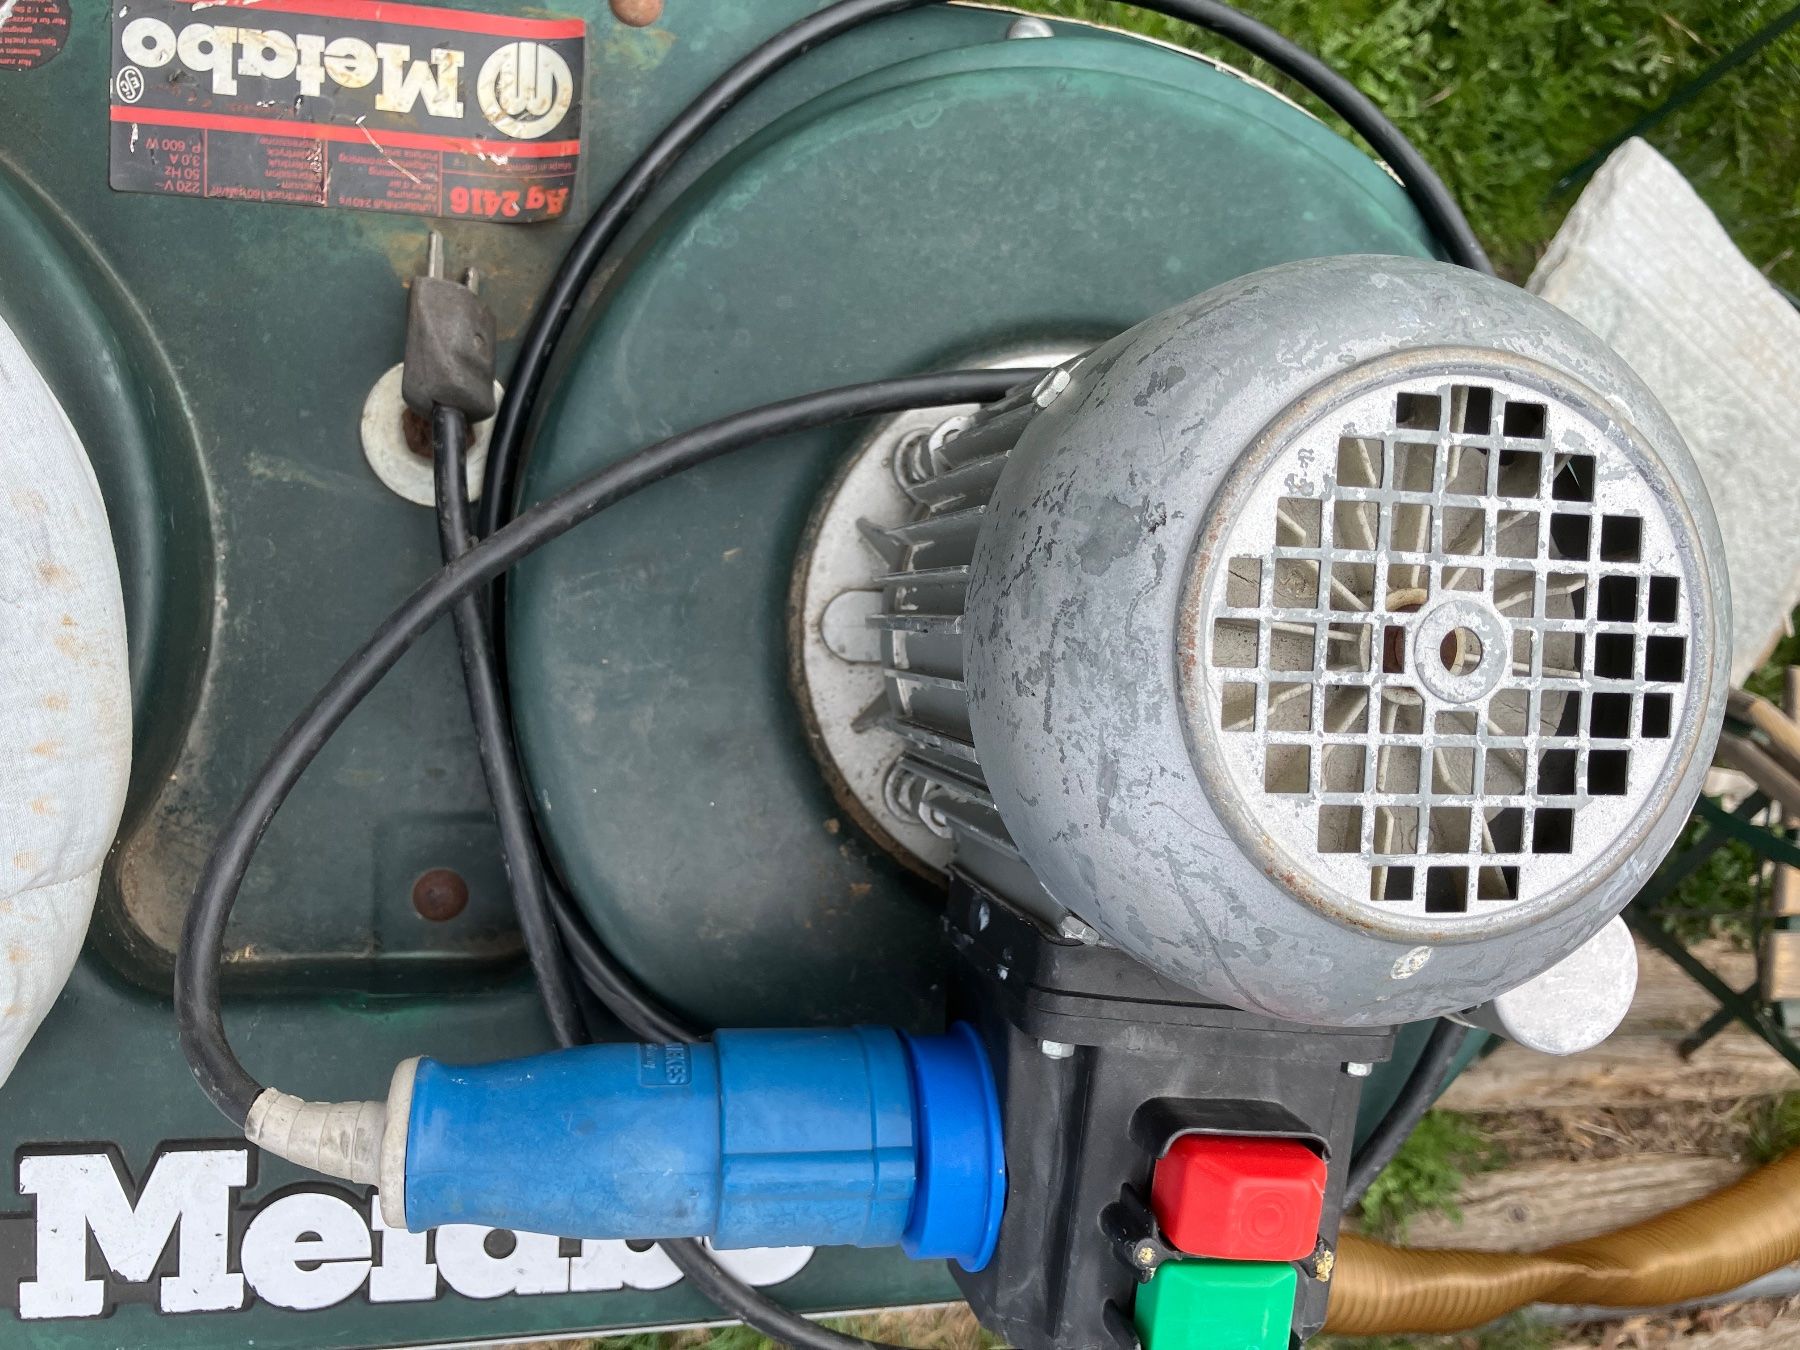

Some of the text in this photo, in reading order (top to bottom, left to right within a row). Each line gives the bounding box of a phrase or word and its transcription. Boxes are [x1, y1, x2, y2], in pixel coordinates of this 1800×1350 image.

[121, 17, 465, 119] Metabo
[144, 137, 159, 149] W
[161, 139, 186, 152] 600
[169, 153, 179, 164] A
[164, 166, 200, 180] 50 Hz
[176, 180, 200, 193] 220
[448, 185, 569, 218] Ag 2416
